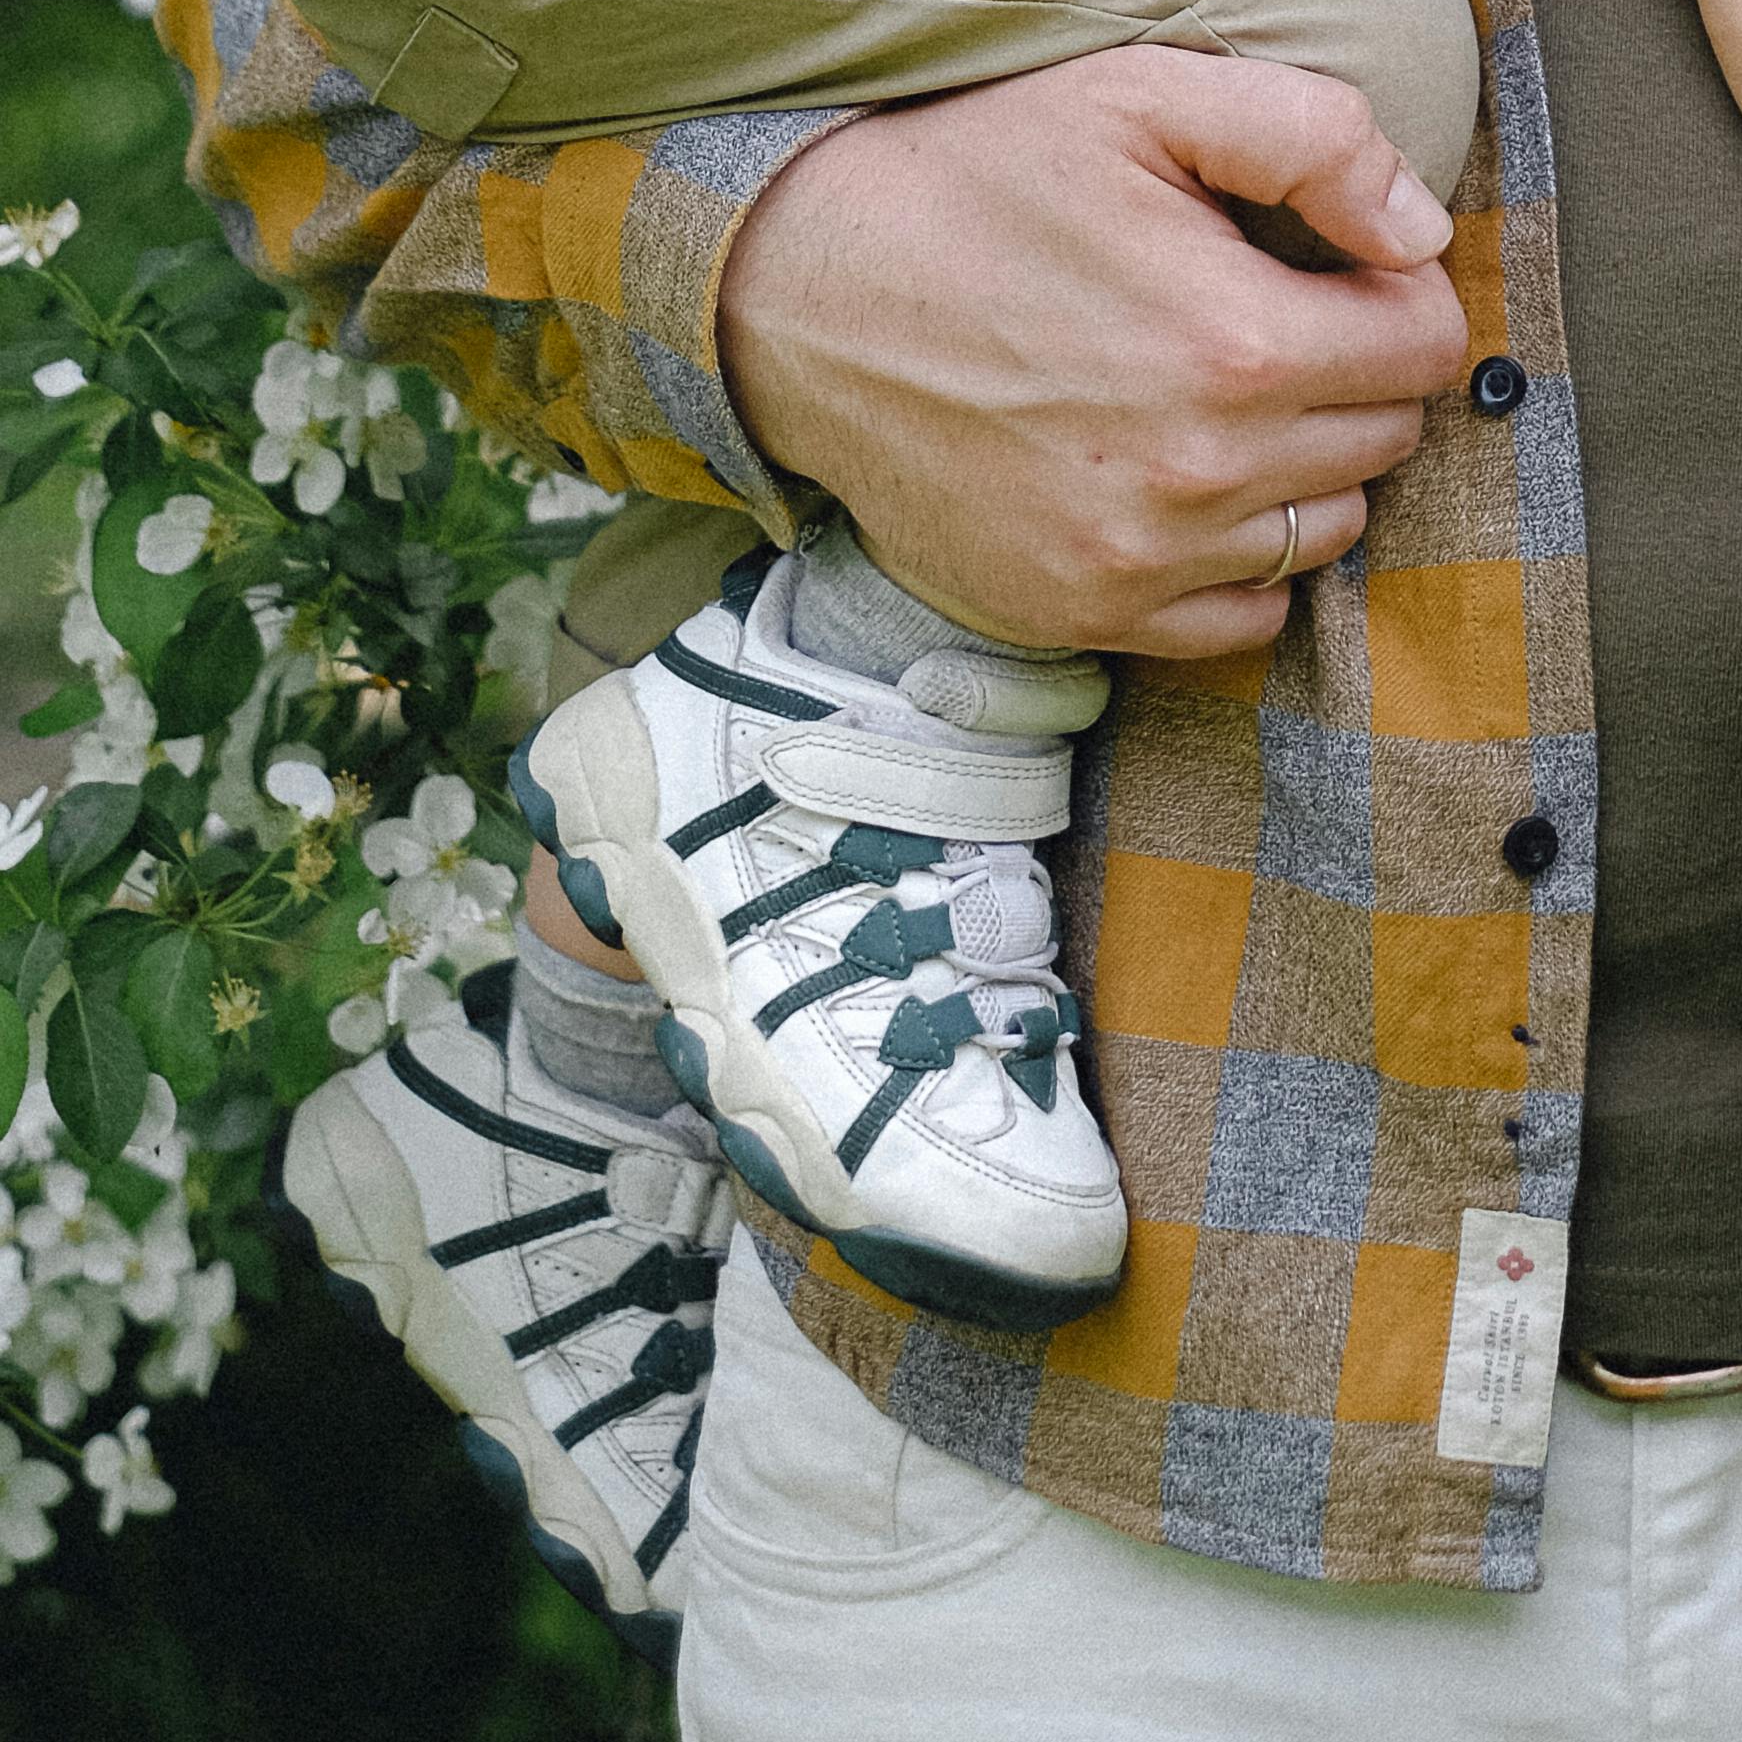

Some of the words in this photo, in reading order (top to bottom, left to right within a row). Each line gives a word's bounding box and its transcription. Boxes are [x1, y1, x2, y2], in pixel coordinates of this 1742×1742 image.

[1484, 1311, 1499, 1348] Shirt
[1511, 1355, 1525, 1392] SINCE
[1491, 1374, 1505, 1425] KOTON
